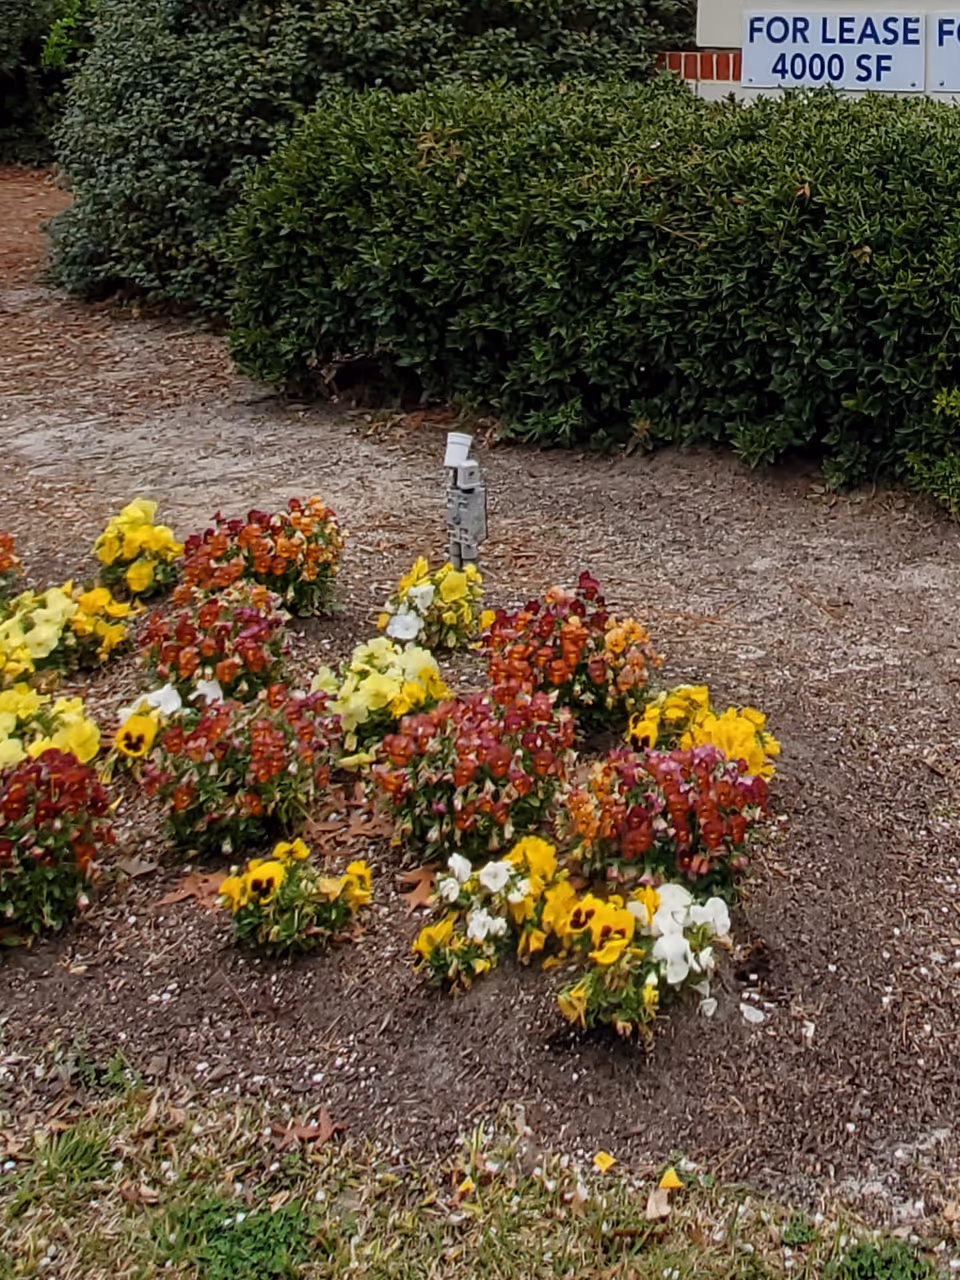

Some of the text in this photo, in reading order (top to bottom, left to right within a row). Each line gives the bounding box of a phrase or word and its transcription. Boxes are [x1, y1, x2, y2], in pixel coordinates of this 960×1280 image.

[748, 16, 921, 45] FOR LEASE
[771, 52, 893, 82] 4000 SF
